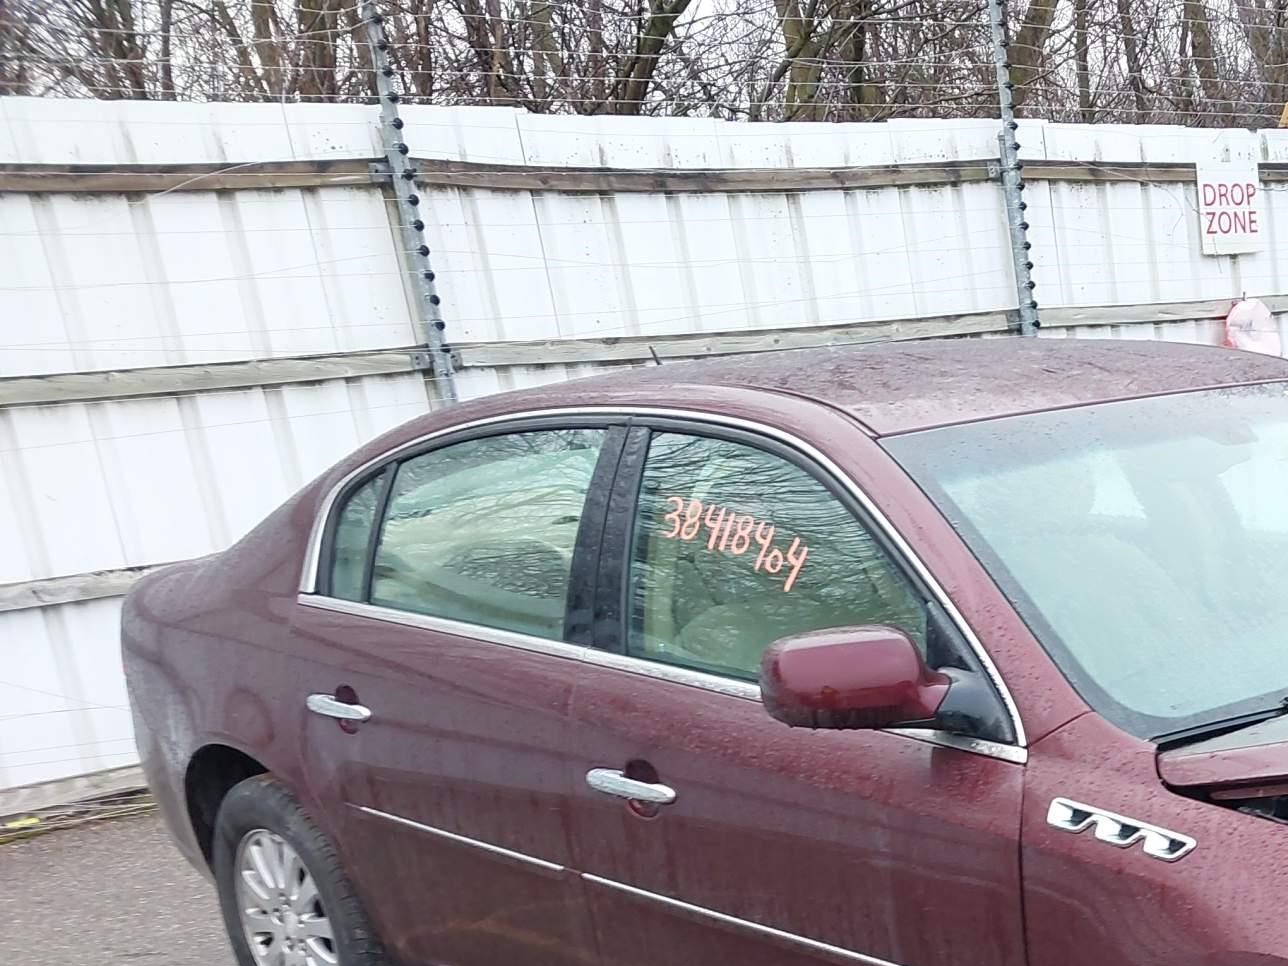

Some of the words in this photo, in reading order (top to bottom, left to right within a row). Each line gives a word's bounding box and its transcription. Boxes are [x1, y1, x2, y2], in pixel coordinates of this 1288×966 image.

[1202, 183, 1256, 207] DROP
[1205, 210, 1258, 234] ZONE
[662, 496, 809, 592] 38418404
